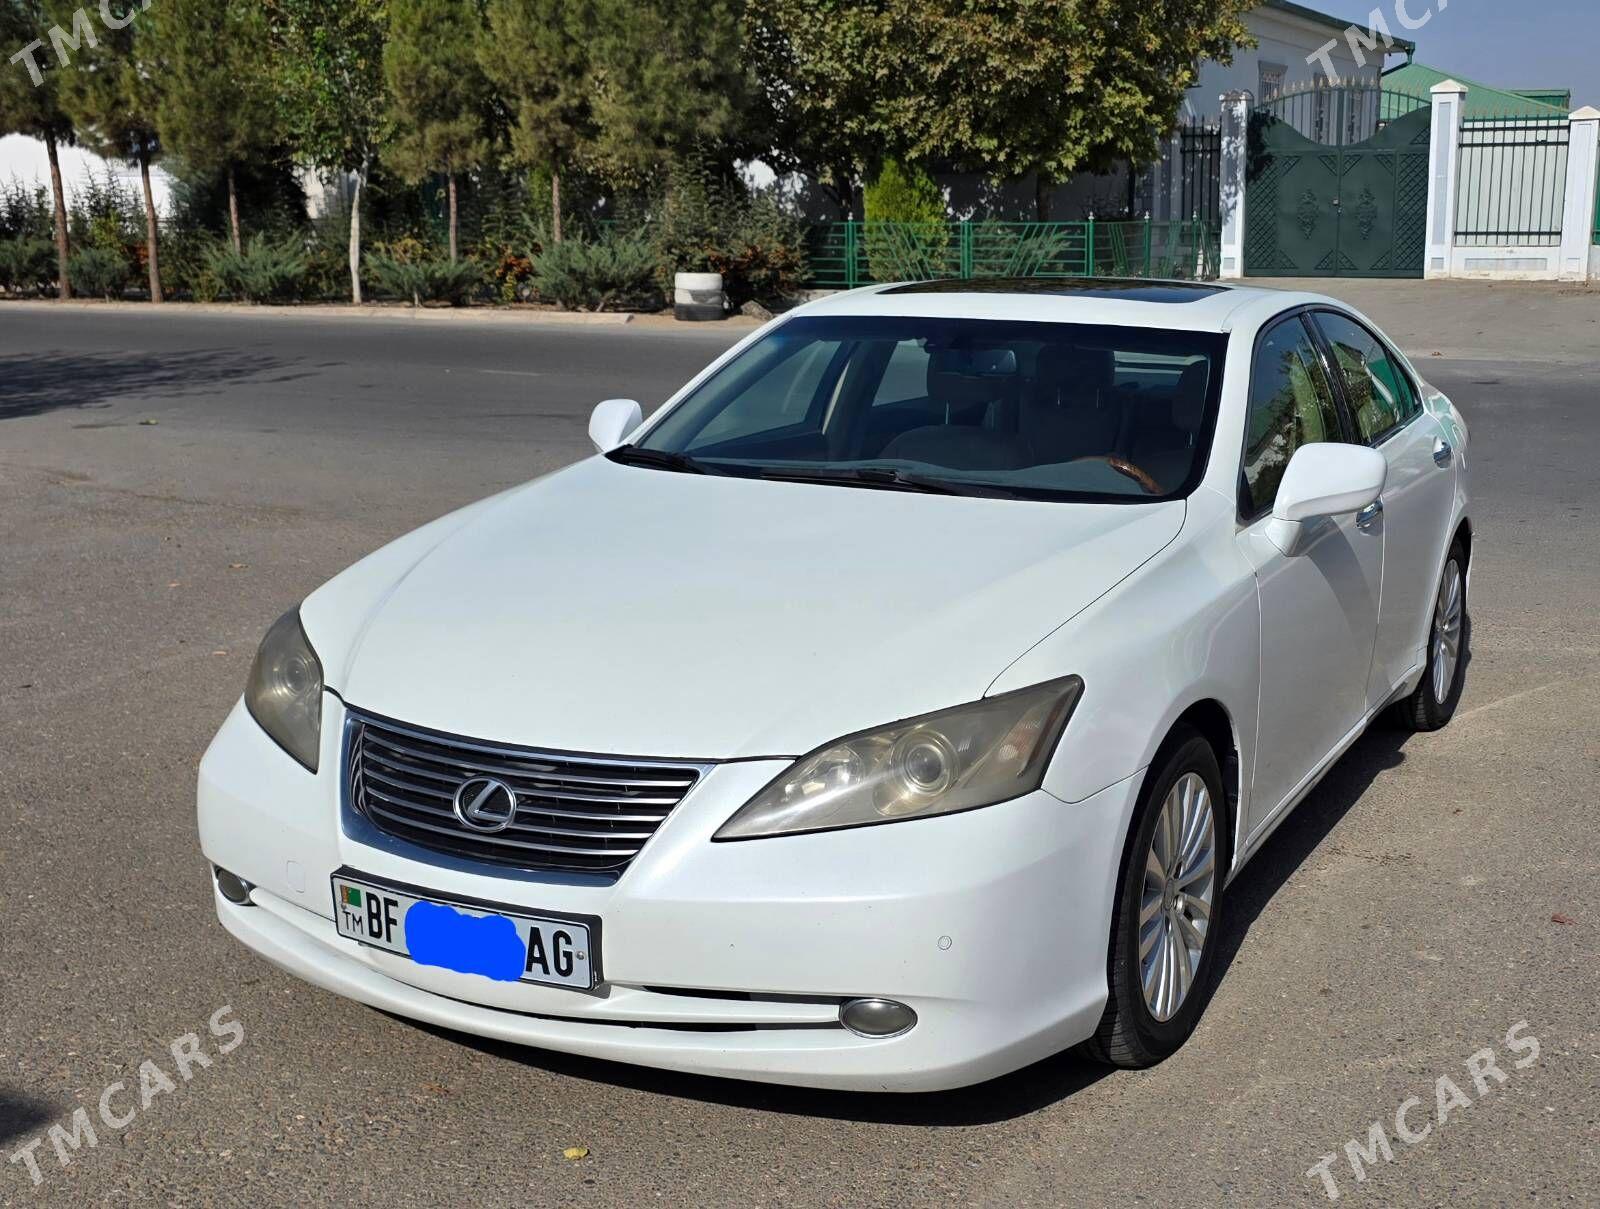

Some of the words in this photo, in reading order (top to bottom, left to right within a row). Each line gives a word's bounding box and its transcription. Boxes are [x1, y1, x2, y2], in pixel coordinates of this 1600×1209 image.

[342, 910, 364, 935] TM
[366, 892, 398, 943] BF
[526, 926, 573, 977] AG
